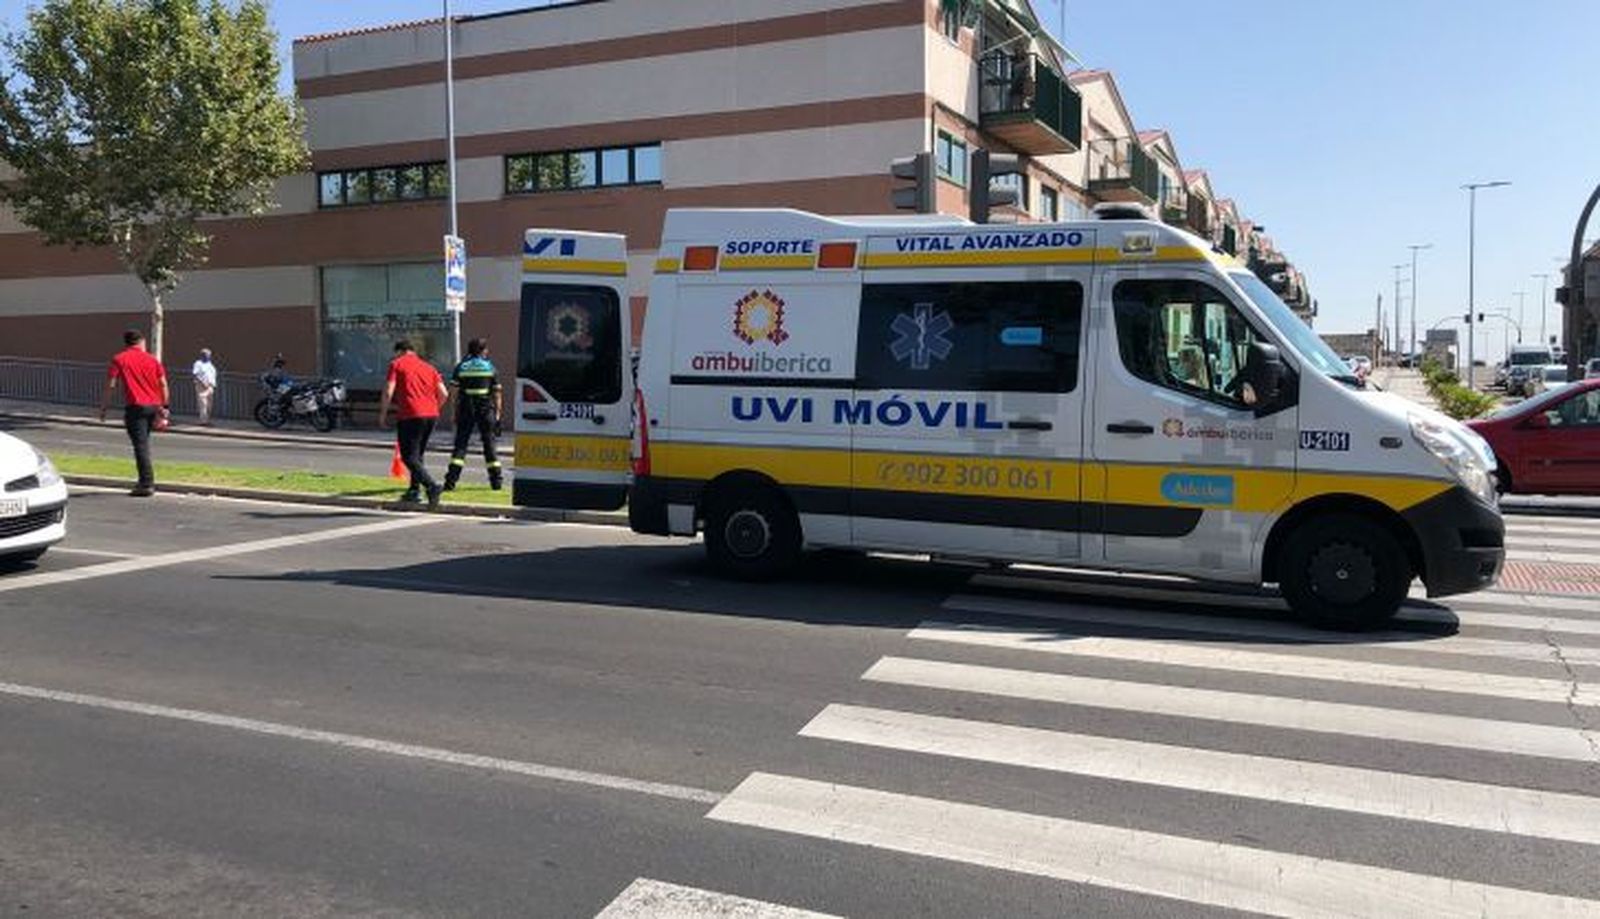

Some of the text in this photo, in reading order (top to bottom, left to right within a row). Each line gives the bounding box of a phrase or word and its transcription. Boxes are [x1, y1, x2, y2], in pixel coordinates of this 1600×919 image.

[725, 231, 1083, 255] SOPORTE VITAL AVANZADO
[692, 352, 832, 373] ambuiberica
[731, 394, 1004, 429] UVI MÓVIL
[1301, 431, 1348, 449] U-2101
[902, 462, 1056, 491] 902 300 061
